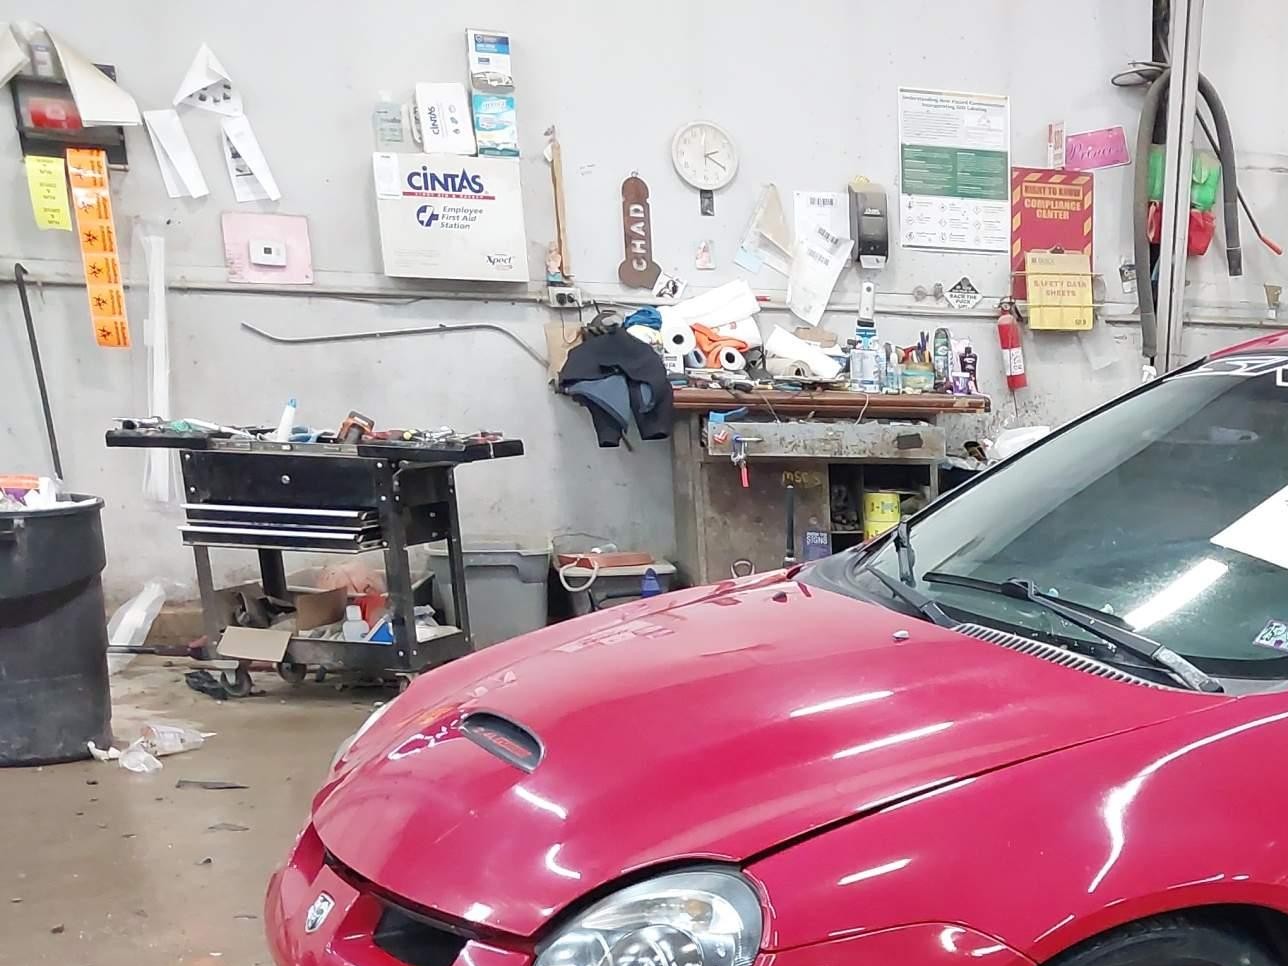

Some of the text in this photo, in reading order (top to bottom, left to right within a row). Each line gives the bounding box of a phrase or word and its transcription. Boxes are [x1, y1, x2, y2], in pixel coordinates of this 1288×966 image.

[1024, 198, 1081, 211] COMPLIANCE
[442, 206, 484, 216] Employee
[1036, 209, 1070, 220] CENTER
[440, 222, 471, 230] Station
[629, 203, 648, 272] CHAD
